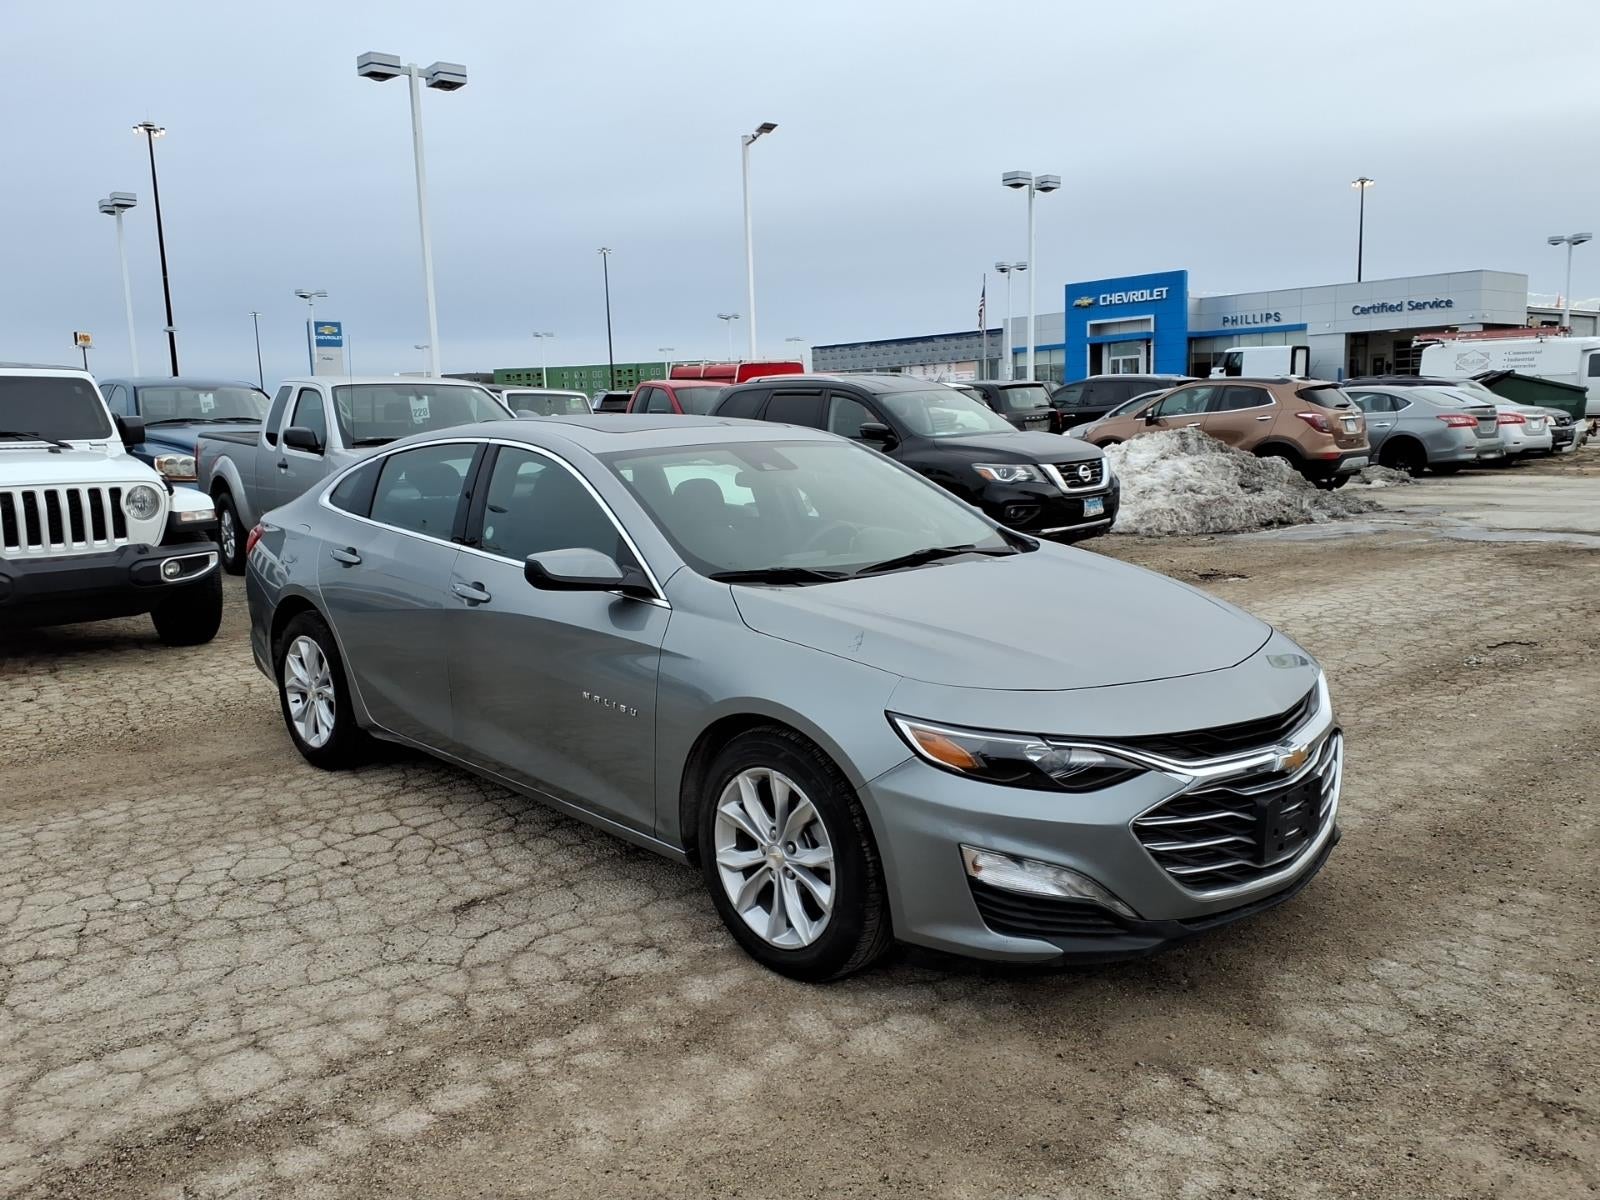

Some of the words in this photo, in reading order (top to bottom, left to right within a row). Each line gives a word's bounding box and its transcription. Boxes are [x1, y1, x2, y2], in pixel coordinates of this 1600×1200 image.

[1100, 287, 1169, 306] CHEVROLET
[1352, 301, 1403, 315] Certified
[1408, 298, 1453, 311] Service
[1222, 312, 1281, 326] PHILLIPS
[413, 407, 428, 417] 228
[583, 691, 637, 717] MALIBU
